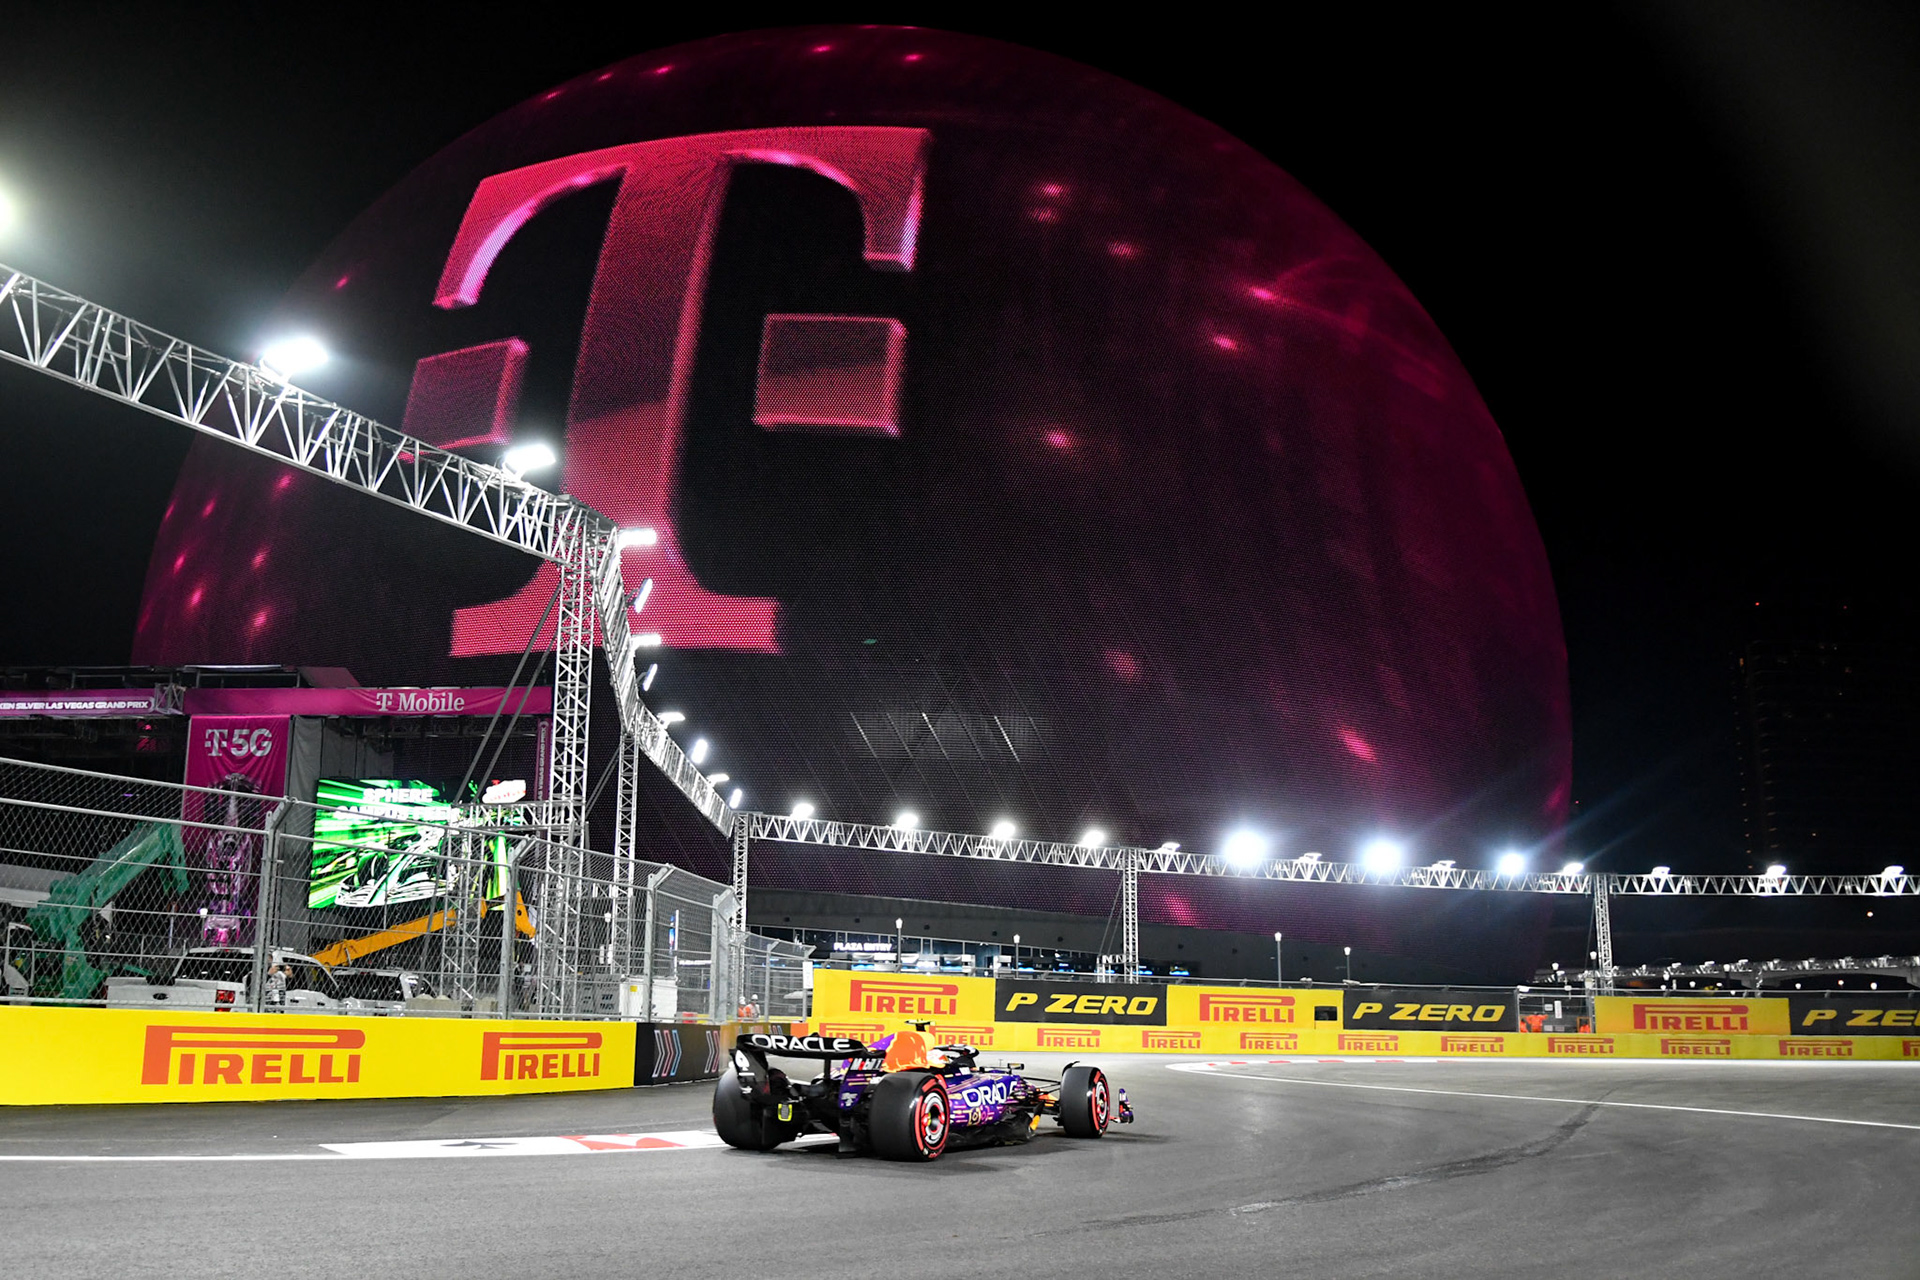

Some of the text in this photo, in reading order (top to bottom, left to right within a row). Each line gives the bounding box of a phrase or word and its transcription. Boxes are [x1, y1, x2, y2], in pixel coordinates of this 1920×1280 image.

[16, 702, 45, 710] SILVER
[127, 701, 148, 709] PRIX
[376, 692, 465, 712] T Mobile
[231, 728, 272, 757] 5G
[363, 788, 433, 803] SPHERE
[833, 942, 893, 952] PLAZA ENTRY
[849, 979, 959, 1015] PIRELLI
[1005, 992, 1160, 1016] P ZERO
[1199, 993, 1296, 1023] PIRELLI
[1353, 1002, 1506, 1022] P ZERO
[1633, 1003, 1749, 1031] PIRELLI
[1802, 1009, 1920, 1027] P ZE
[750, 1034, 851, 1053] ORACLE
[1036, 1028, 1101, 1048] PIRELLI
[1141, 1030, 1203, 1048] PIRELLI
[1240, 1032, 1298, 1050] PIRELLI
[1338, 1034, 1399, 1051] PIRELLI
[1441, 1036, 1504, 1053] PIRELLI
[1548, 1037, 1614, 1054] PIRELLI
[1661, 1038, 1731, 1055] PIRELLI
[141, 1025, 366, 1085] PIRELLI
[480, 1031, 603, 1081] PIRELLI
[1779, 1039, 1853, 1056] PIRELLI
